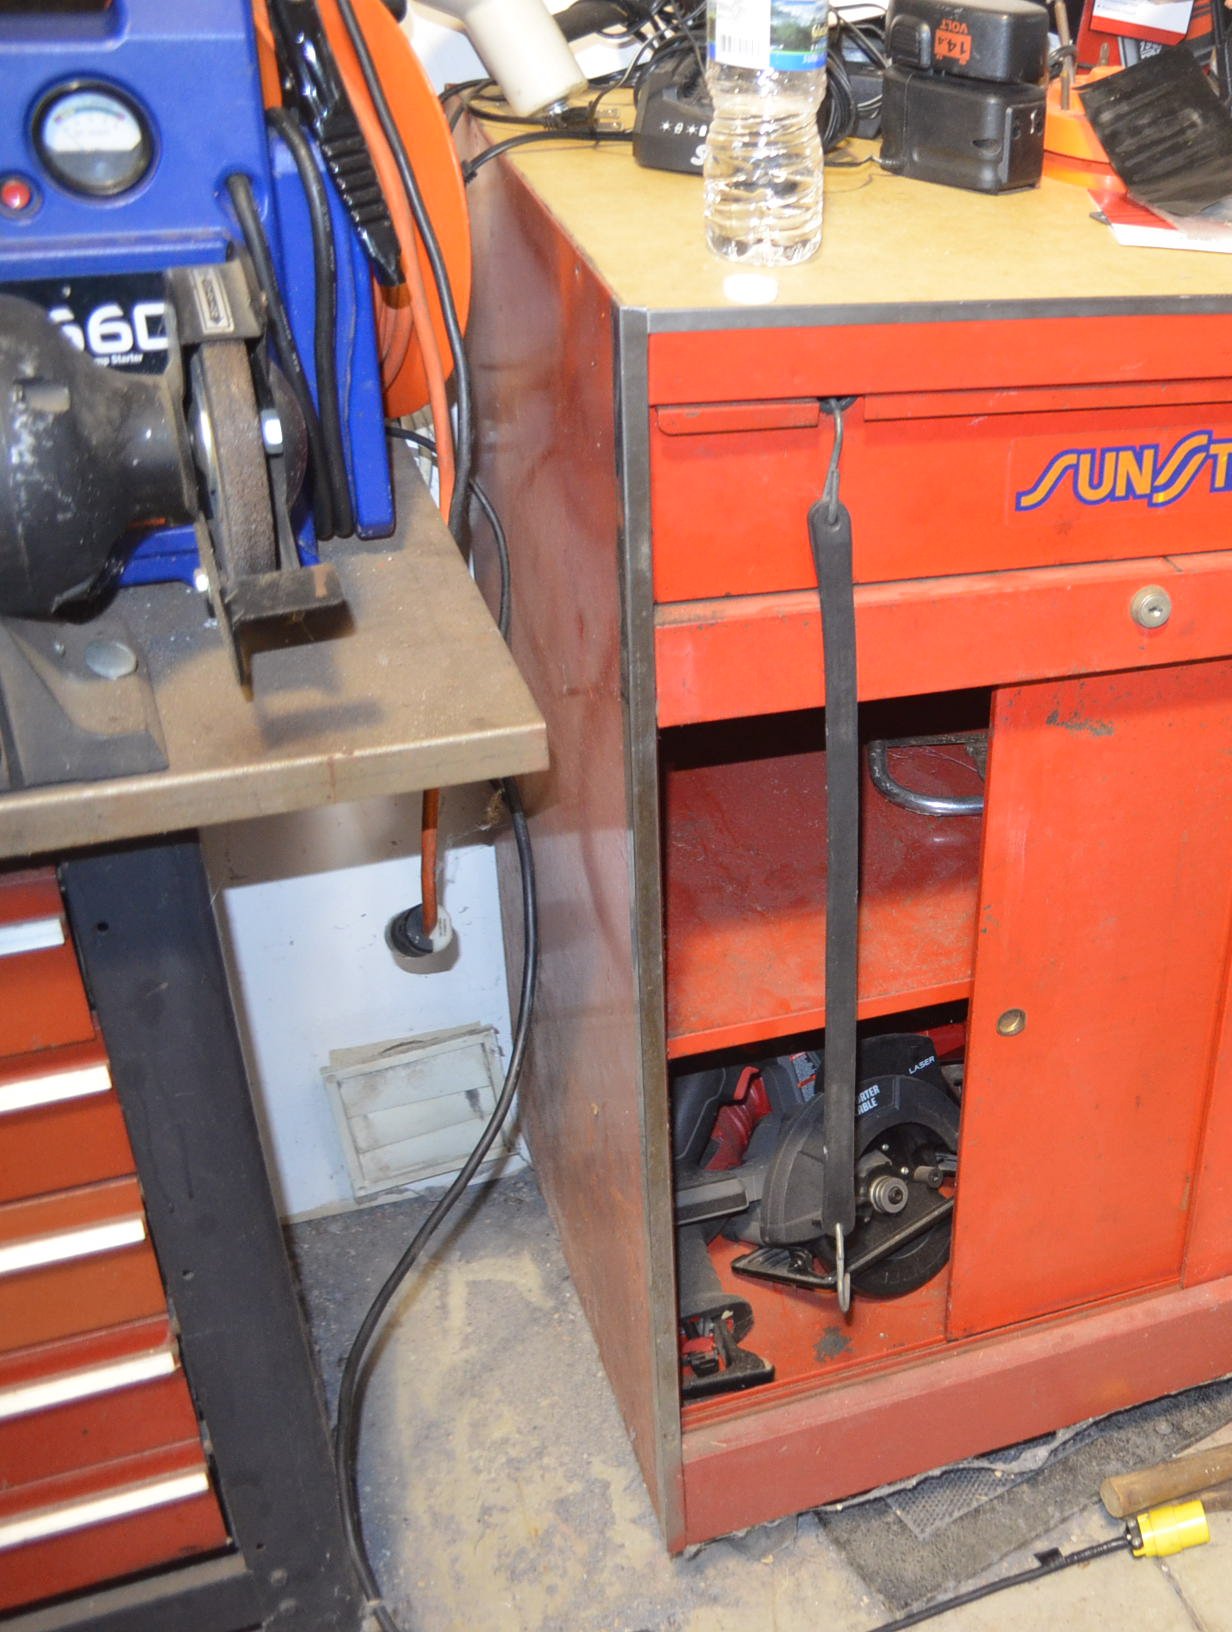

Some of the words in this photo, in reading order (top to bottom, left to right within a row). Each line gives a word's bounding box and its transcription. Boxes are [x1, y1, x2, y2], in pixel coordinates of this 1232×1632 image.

[908, 1055, 936, 1074] LASER
[858, 1084, 880, 1104] RTER
[857, 1097, 879, 1115] ABLE
